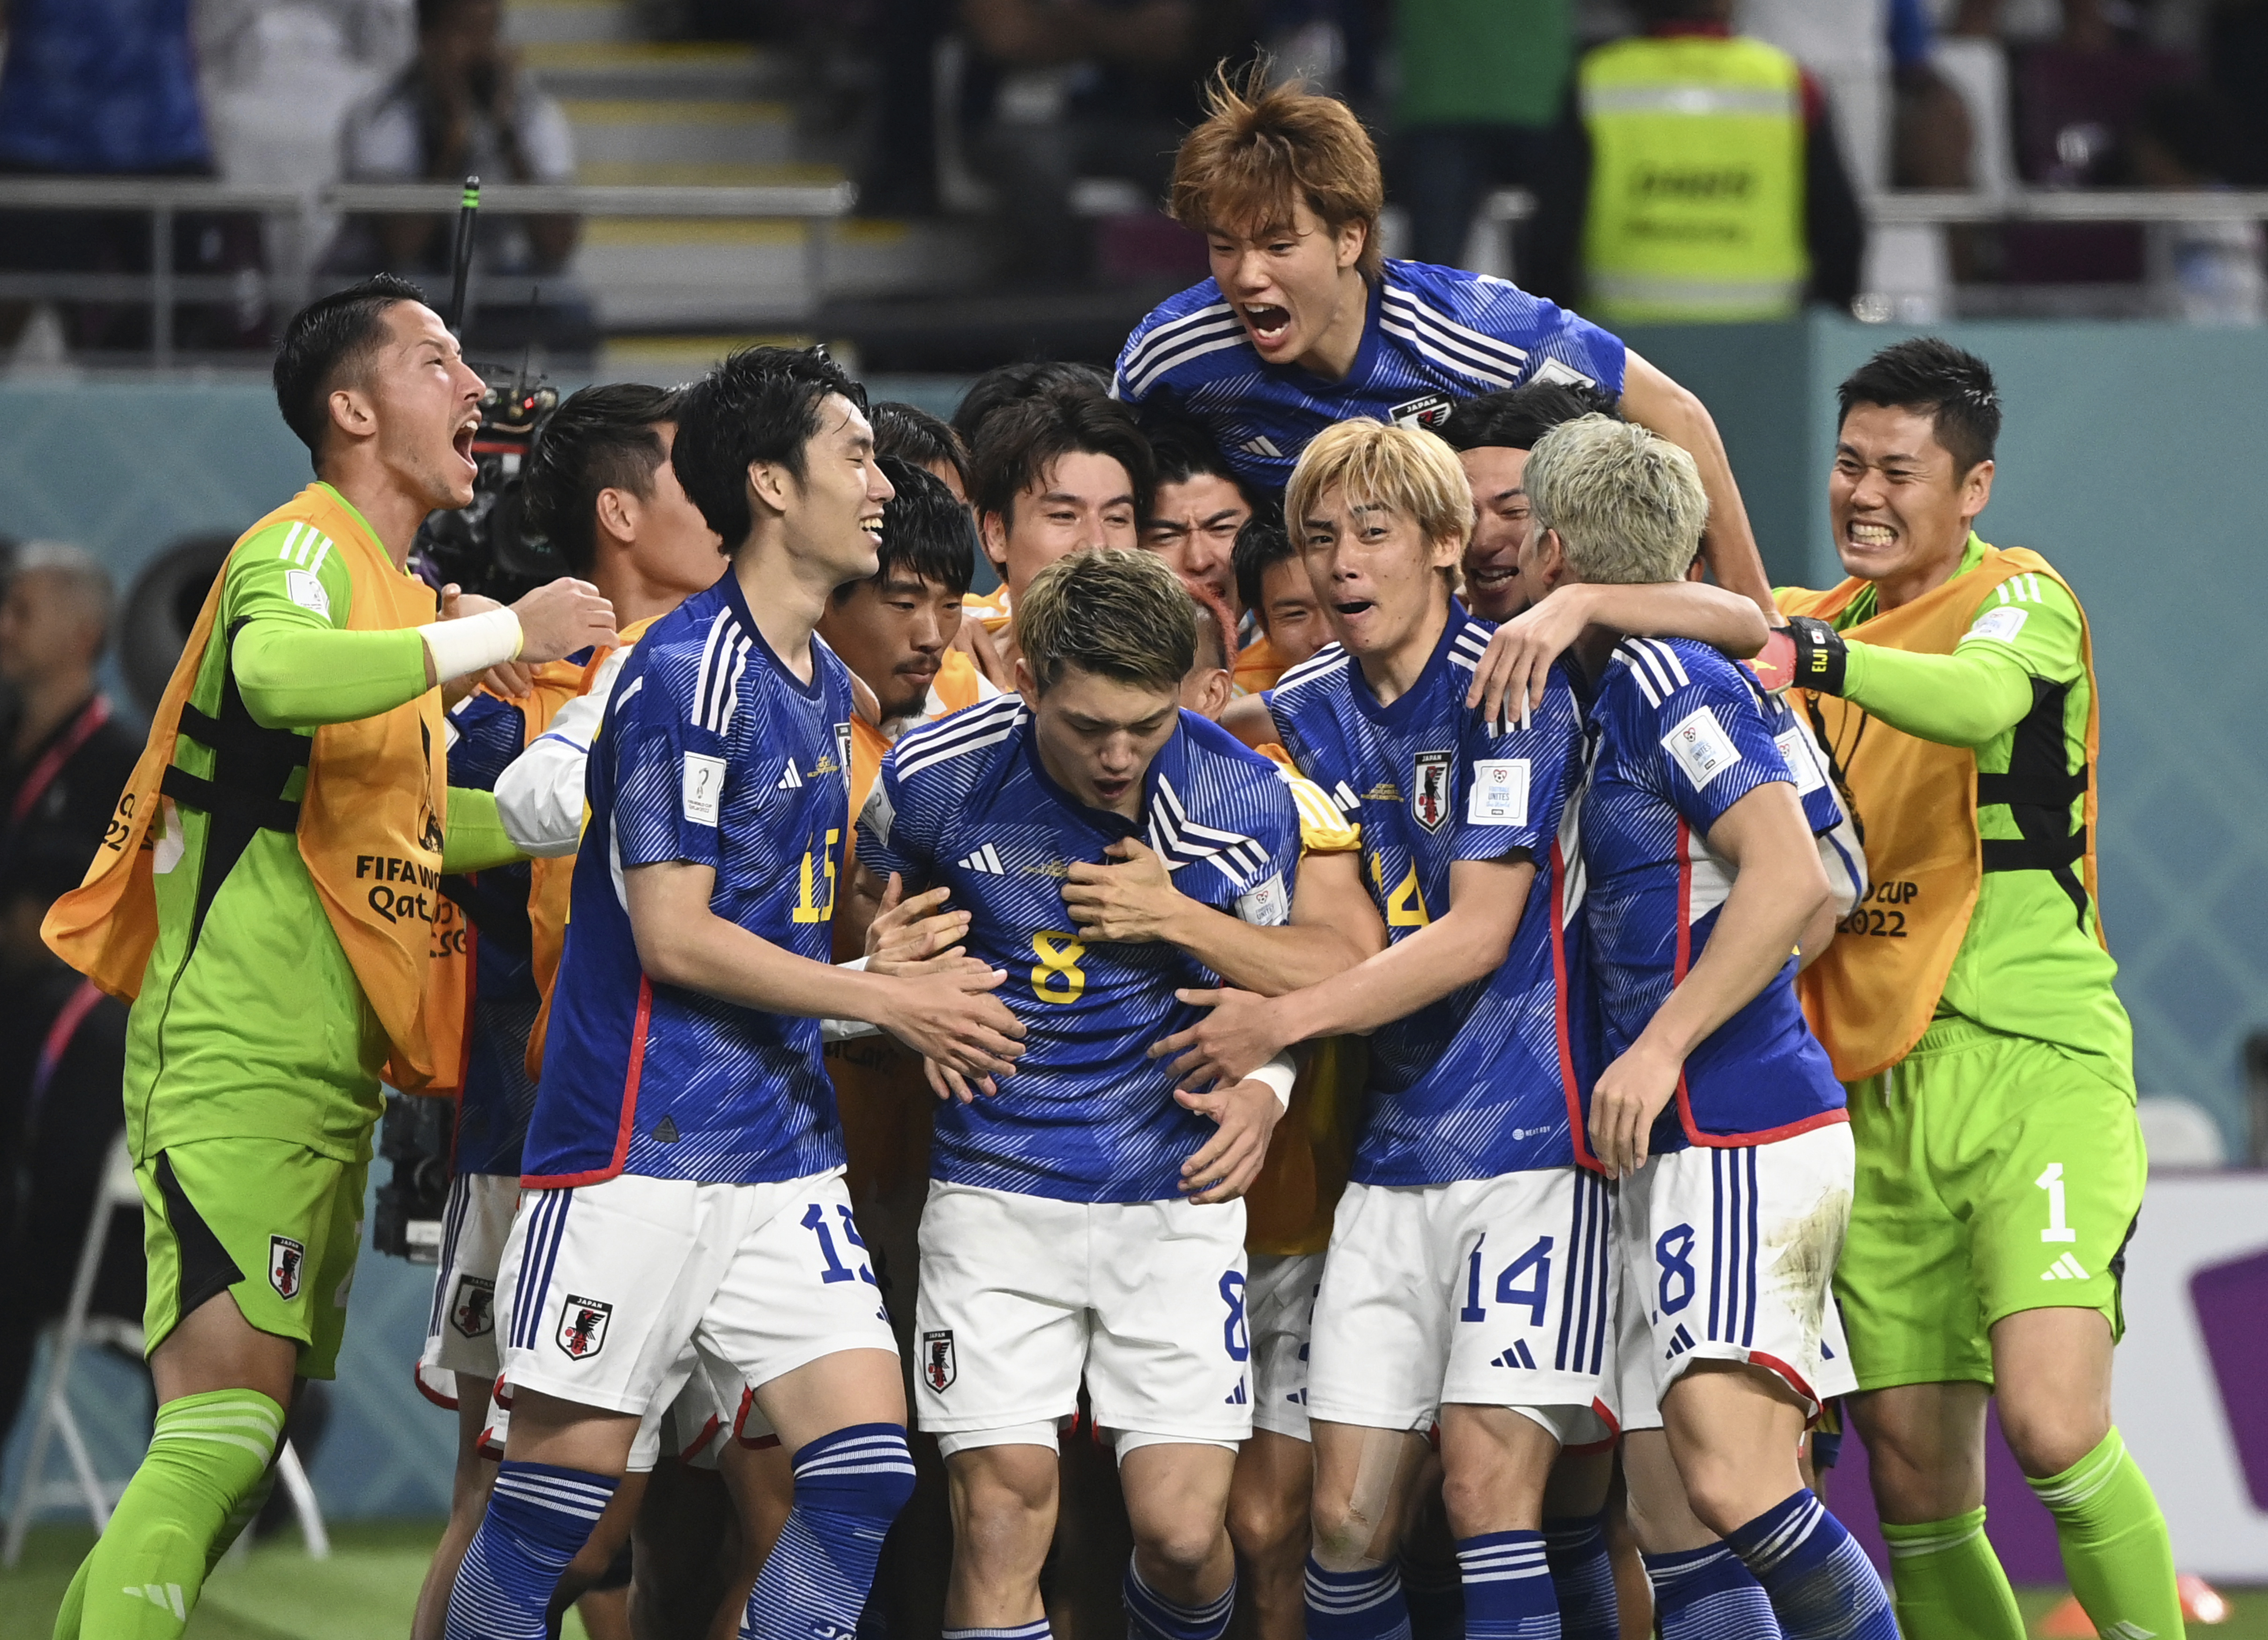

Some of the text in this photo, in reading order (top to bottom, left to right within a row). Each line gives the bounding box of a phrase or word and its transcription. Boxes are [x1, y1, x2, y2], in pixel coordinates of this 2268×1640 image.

[1407, 398, 1437, 413] JAPAN
[1812, 649, 1828, 672] EIJI
[356, 855, 417, 885] FIFA
[793, 828, 839, 923] 15
[368, 886, 433, 924] Qat
[1876, 881, 1918, 904] CUP
[1031, 930, 1085, 1004] 8
[2034, 1163, 2075, 1243] 1
[280, 1239, 299, 1248] JAPAN
[1460, 1232, 1554, 1327] 14
[577, 1298, 602, 1308] JAPAN
[1219, 1270, 1249, 1362] 8
